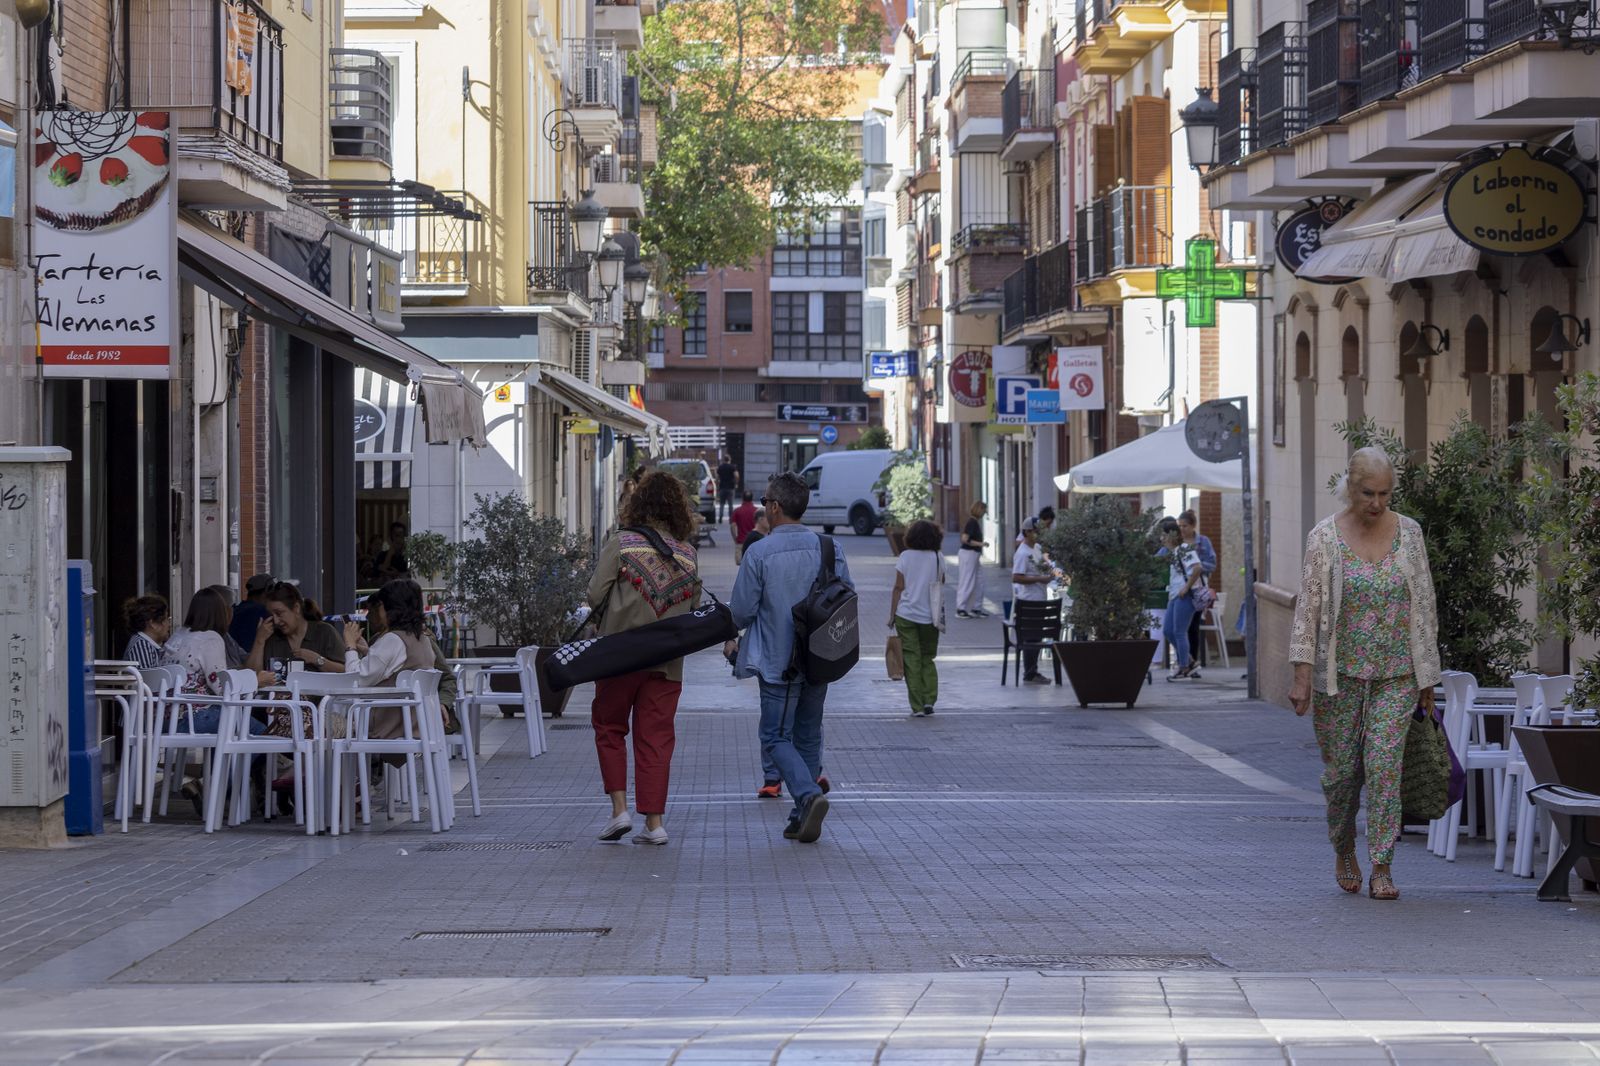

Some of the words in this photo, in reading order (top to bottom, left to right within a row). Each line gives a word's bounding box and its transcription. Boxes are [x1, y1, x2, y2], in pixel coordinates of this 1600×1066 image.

[1474, 217, 1559, 242] condado
[77, 286, 106, 305] Las
[37, 299, 156, 332] Alemanas
[66, 350, 94, 361] desde
[96, 350, 121, 361] 1982
[963, 351, 989, 369] 1900
[1063, 359, 1097, 368] Galletas
[1006, 380, 1031, 413] P
